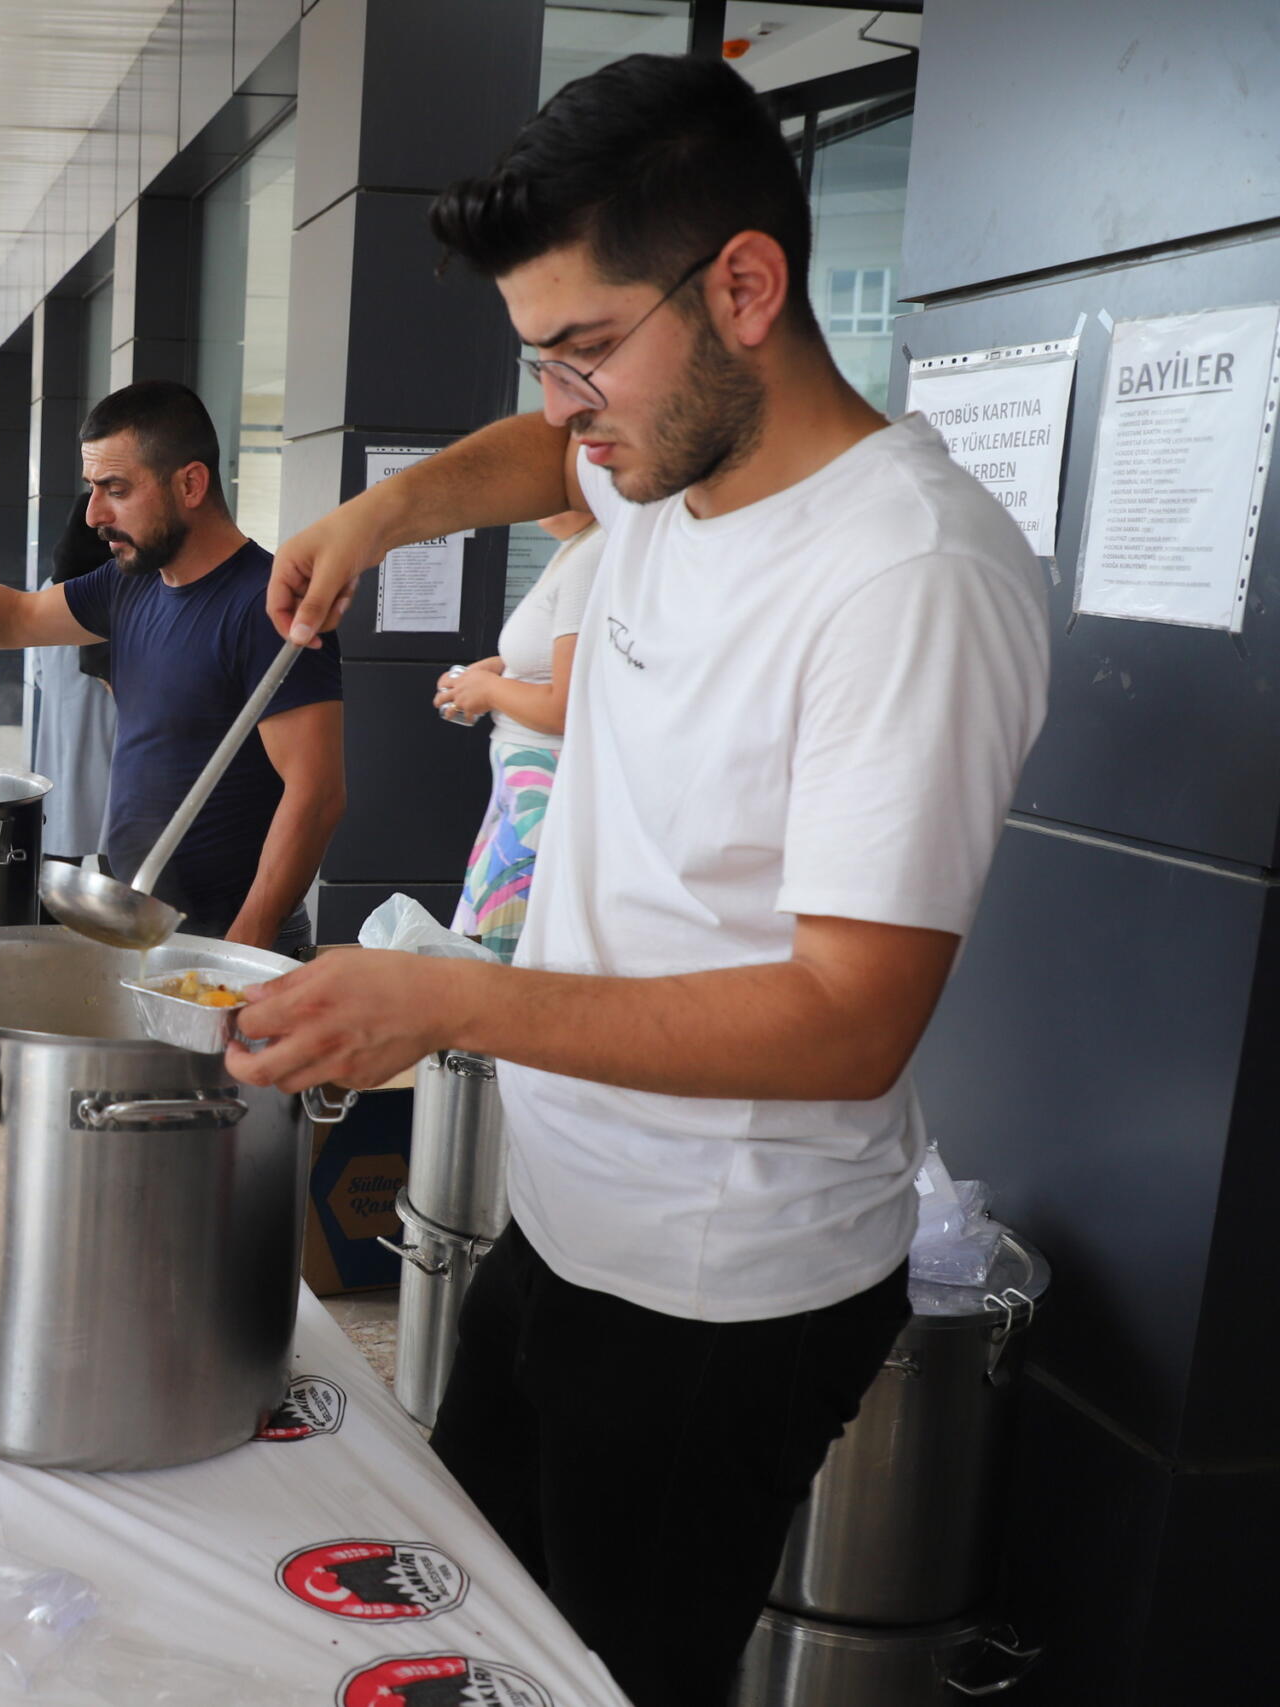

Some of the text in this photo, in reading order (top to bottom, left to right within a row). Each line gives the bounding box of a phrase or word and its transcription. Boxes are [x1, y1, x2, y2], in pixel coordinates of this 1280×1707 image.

[1118, 351, 1234, 395] BAYİLER
[928, 398, 1042, 428] OTOBÜS KARTINA
[962, 424, 1051, 453] YÜKLEMELERİ
